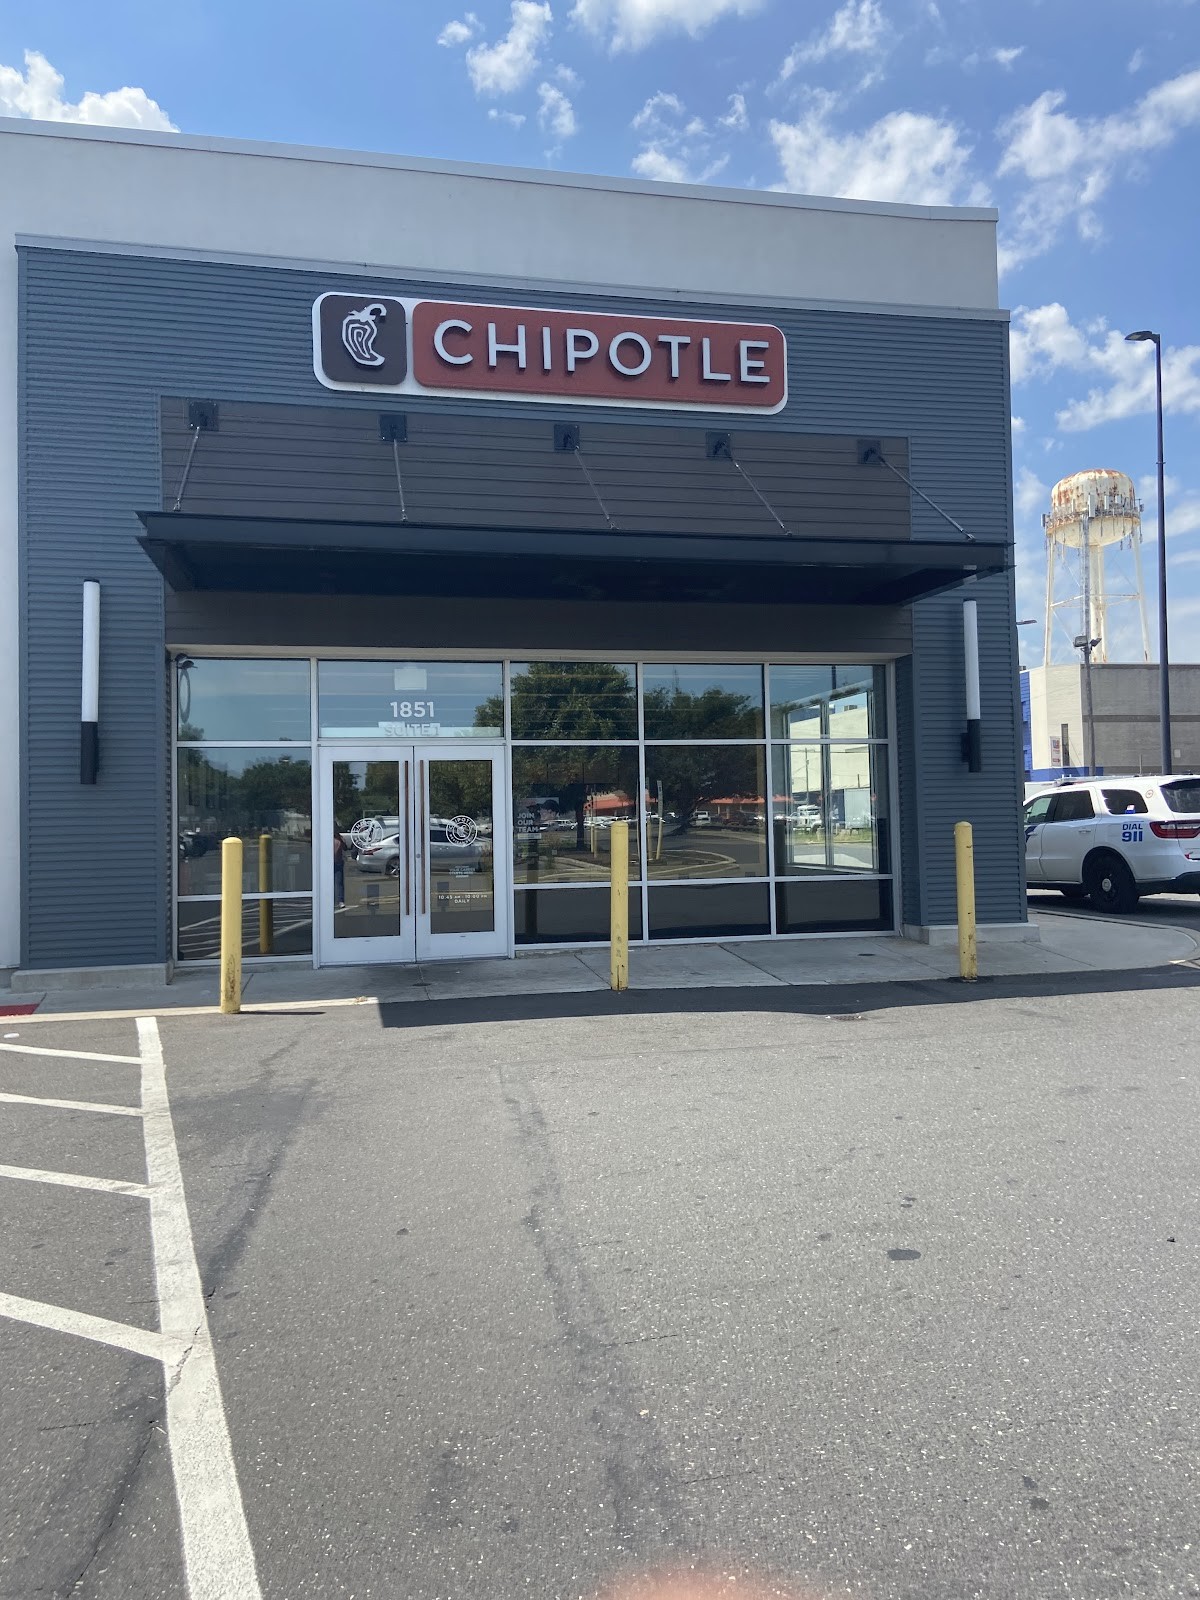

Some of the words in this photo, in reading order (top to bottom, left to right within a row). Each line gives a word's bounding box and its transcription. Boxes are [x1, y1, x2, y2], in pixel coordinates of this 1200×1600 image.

[434, 319, 770, 384] CHIPOTLE
[390, 701, 434, 718] 1851
[384, 723, 430, 737] SUITE
[1122, 823, 1143, 831] DIAL
[1122, 831, 1143, 842] 911
